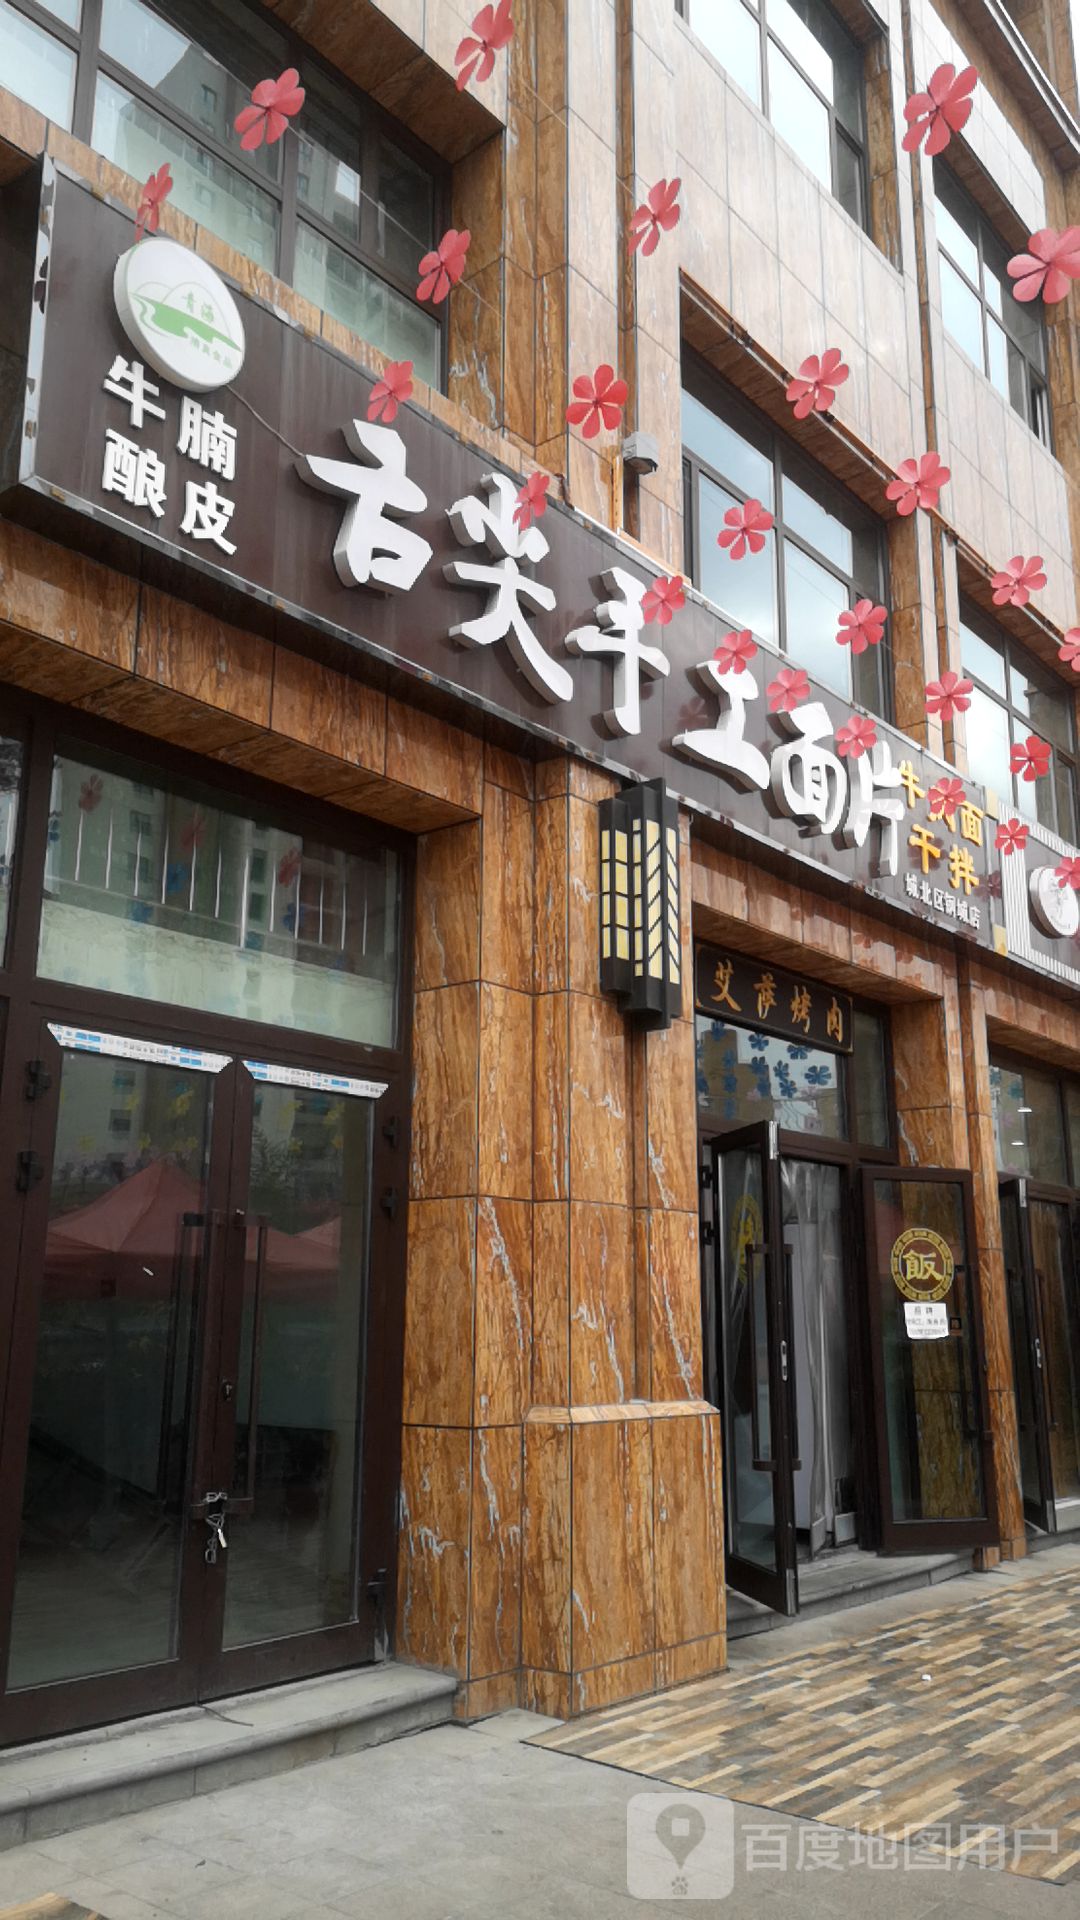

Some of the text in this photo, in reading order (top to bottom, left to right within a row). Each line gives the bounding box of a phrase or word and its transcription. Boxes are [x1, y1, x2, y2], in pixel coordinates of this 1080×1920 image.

[908, 823, 980, 896] 干拌
[710, 958, 844, 1044] 艾萨烤肉
